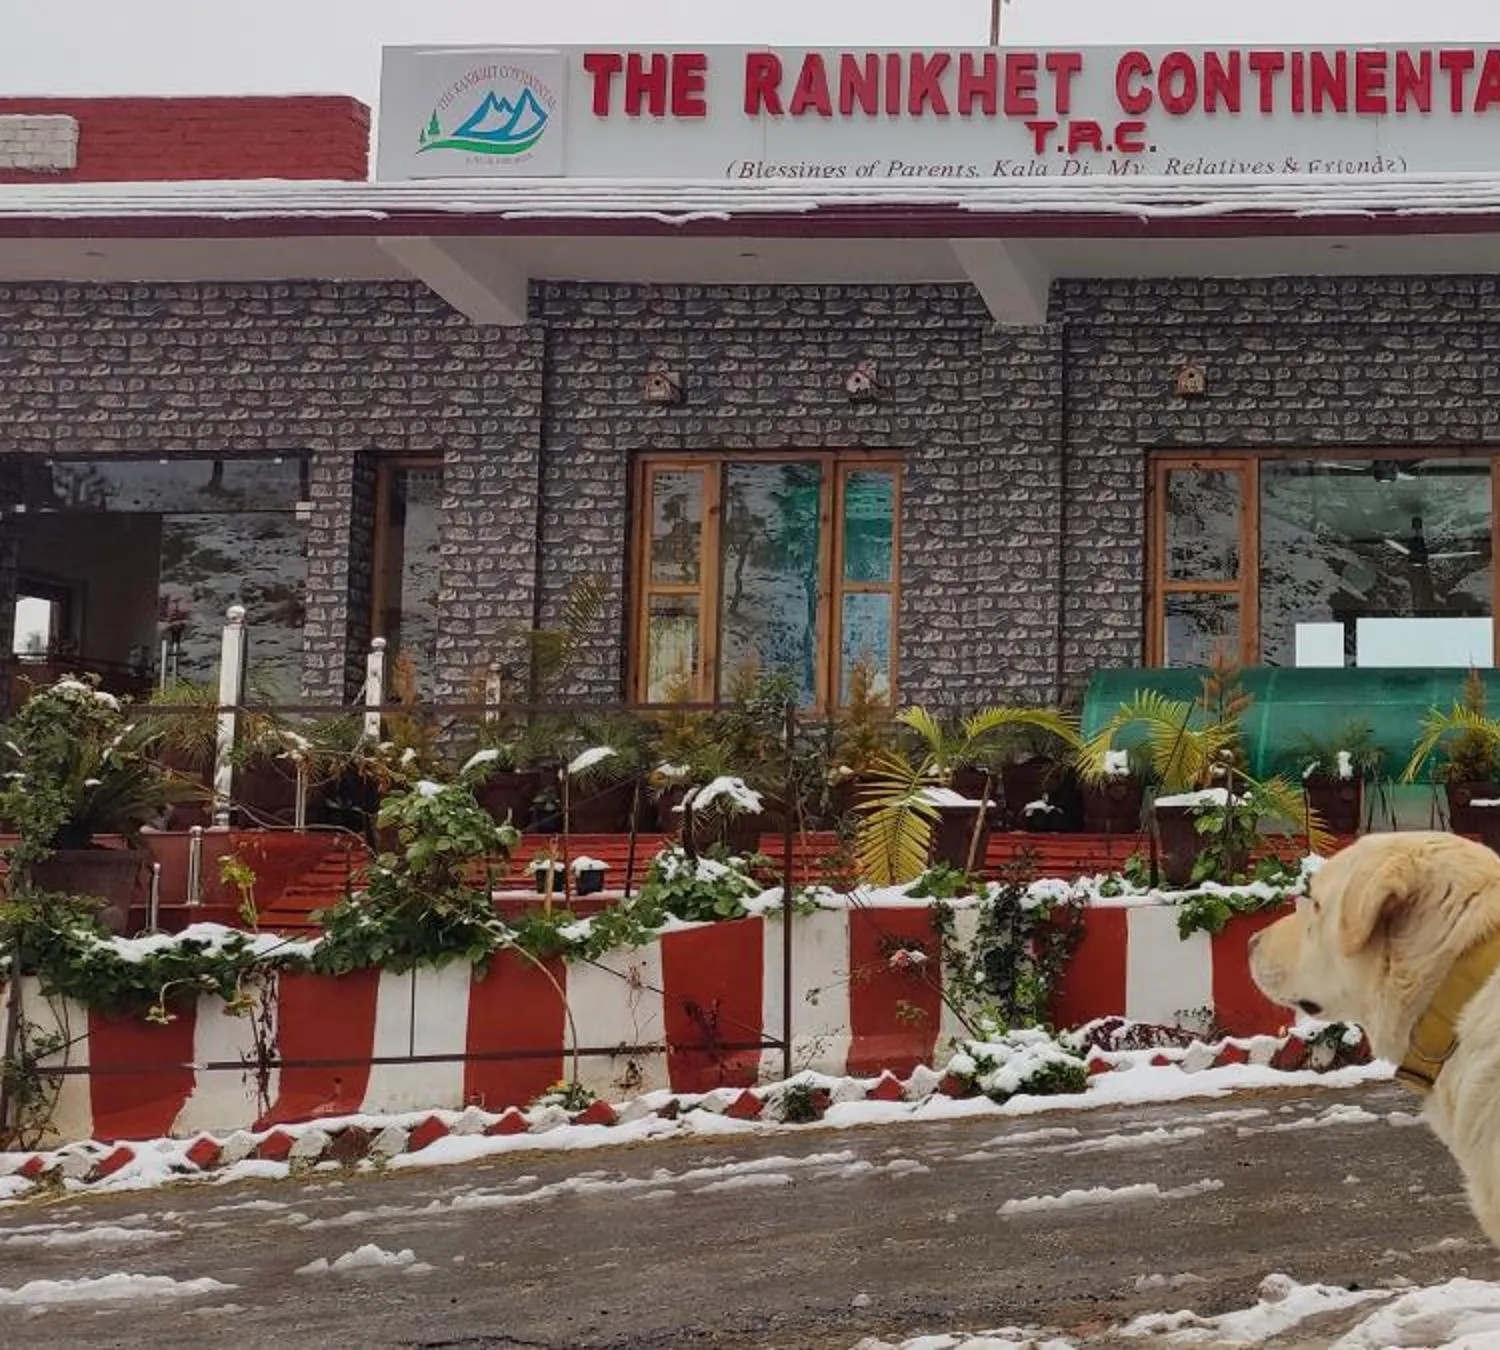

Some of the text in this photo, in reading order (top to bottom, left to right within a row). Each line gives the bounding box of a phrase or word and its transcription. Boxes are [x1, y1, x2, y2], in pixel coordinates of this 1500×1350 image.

[583, 52, 707, 117] THE
[744, 51, 1083, 117] RANIKHET
[1023, 120, 1158, 155] T.R.C.
[725, 159, 848, 179] (Blessings
[856, 159, 881, 178] of
[992, 159, 1049, 178] Kala
[1164, 156, 1276, 176] Relatives
[1282, 156, 1299, 175] &
